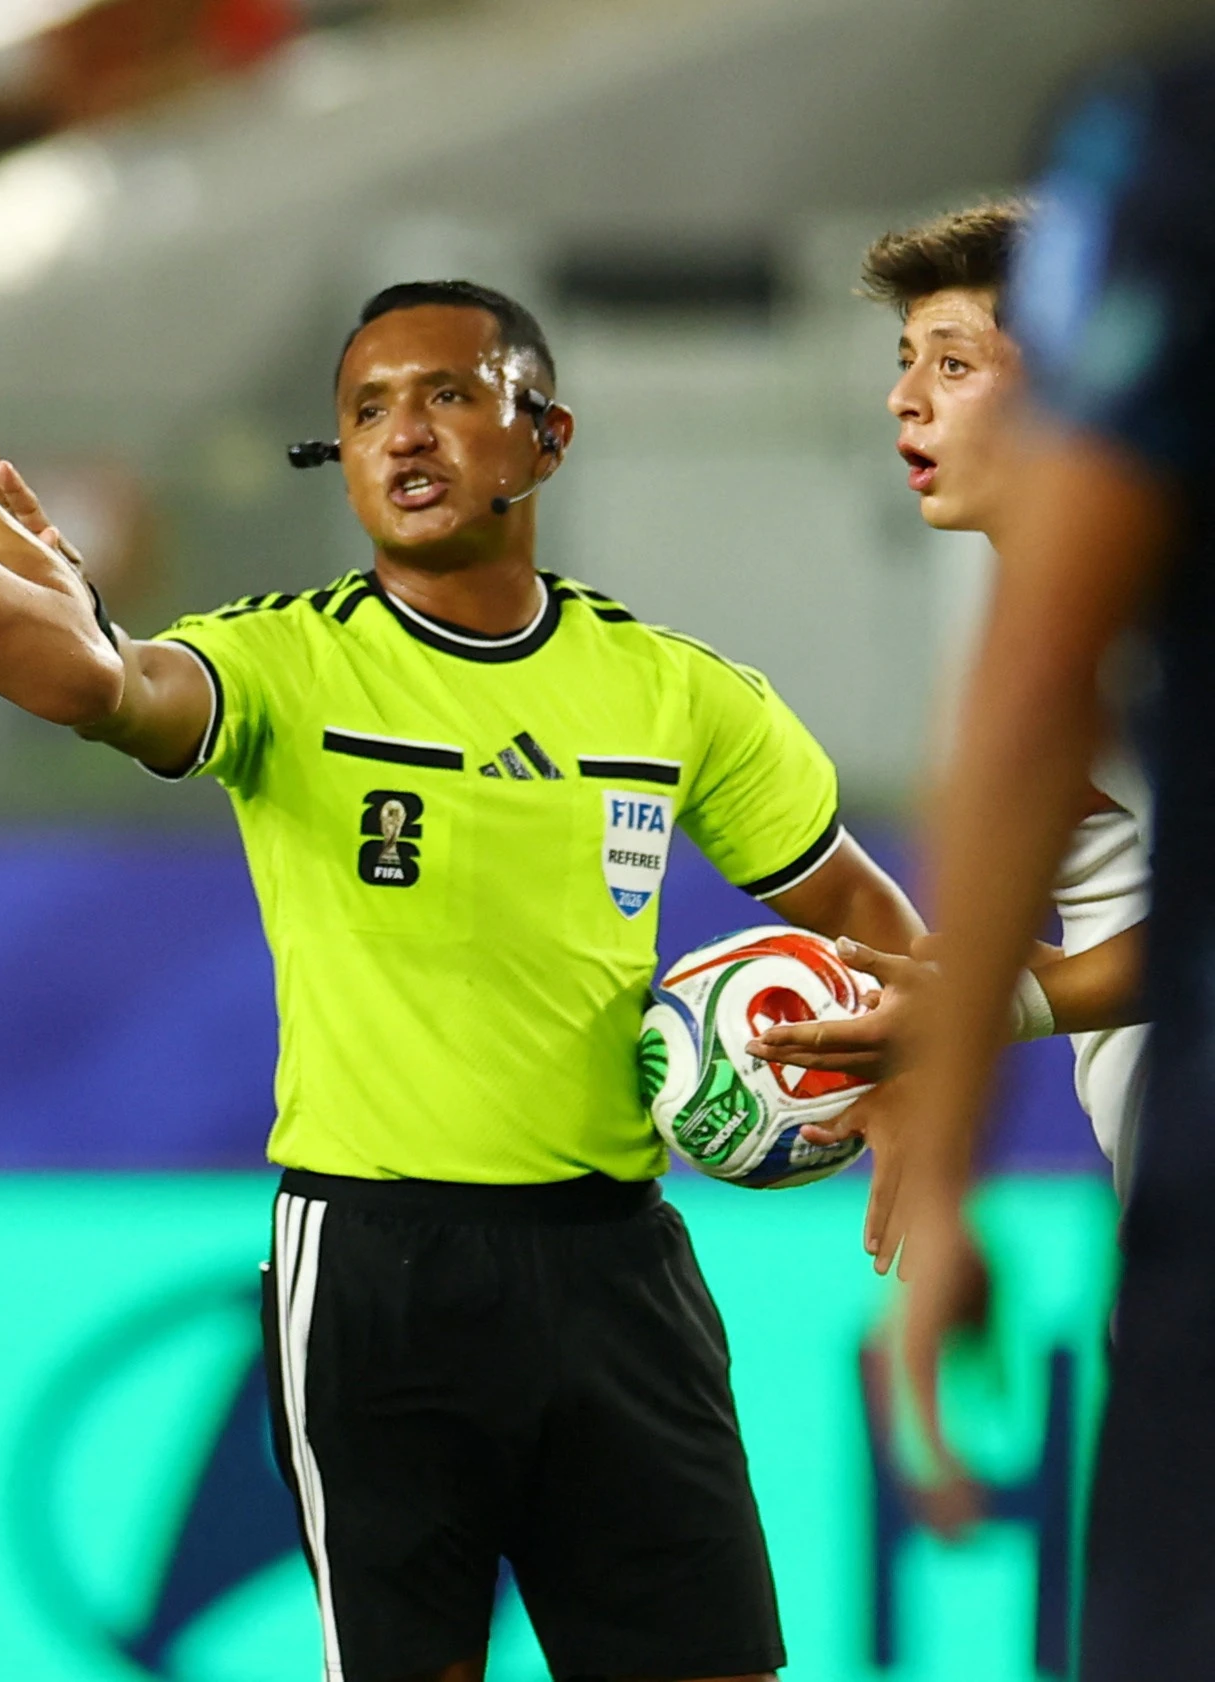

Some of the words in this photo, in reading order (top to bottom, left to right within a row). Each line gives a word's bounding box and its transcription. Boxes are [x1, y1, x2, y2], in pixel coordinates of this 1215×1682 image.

[612, 799, 664, 833] FIFA
[607, 848, 661, 870] REFEREE
[374, 866, 405, 879] FIFA
[619, 892, 643, 907] 2026
[701, 1109, 749, 1156] TRIONDA
